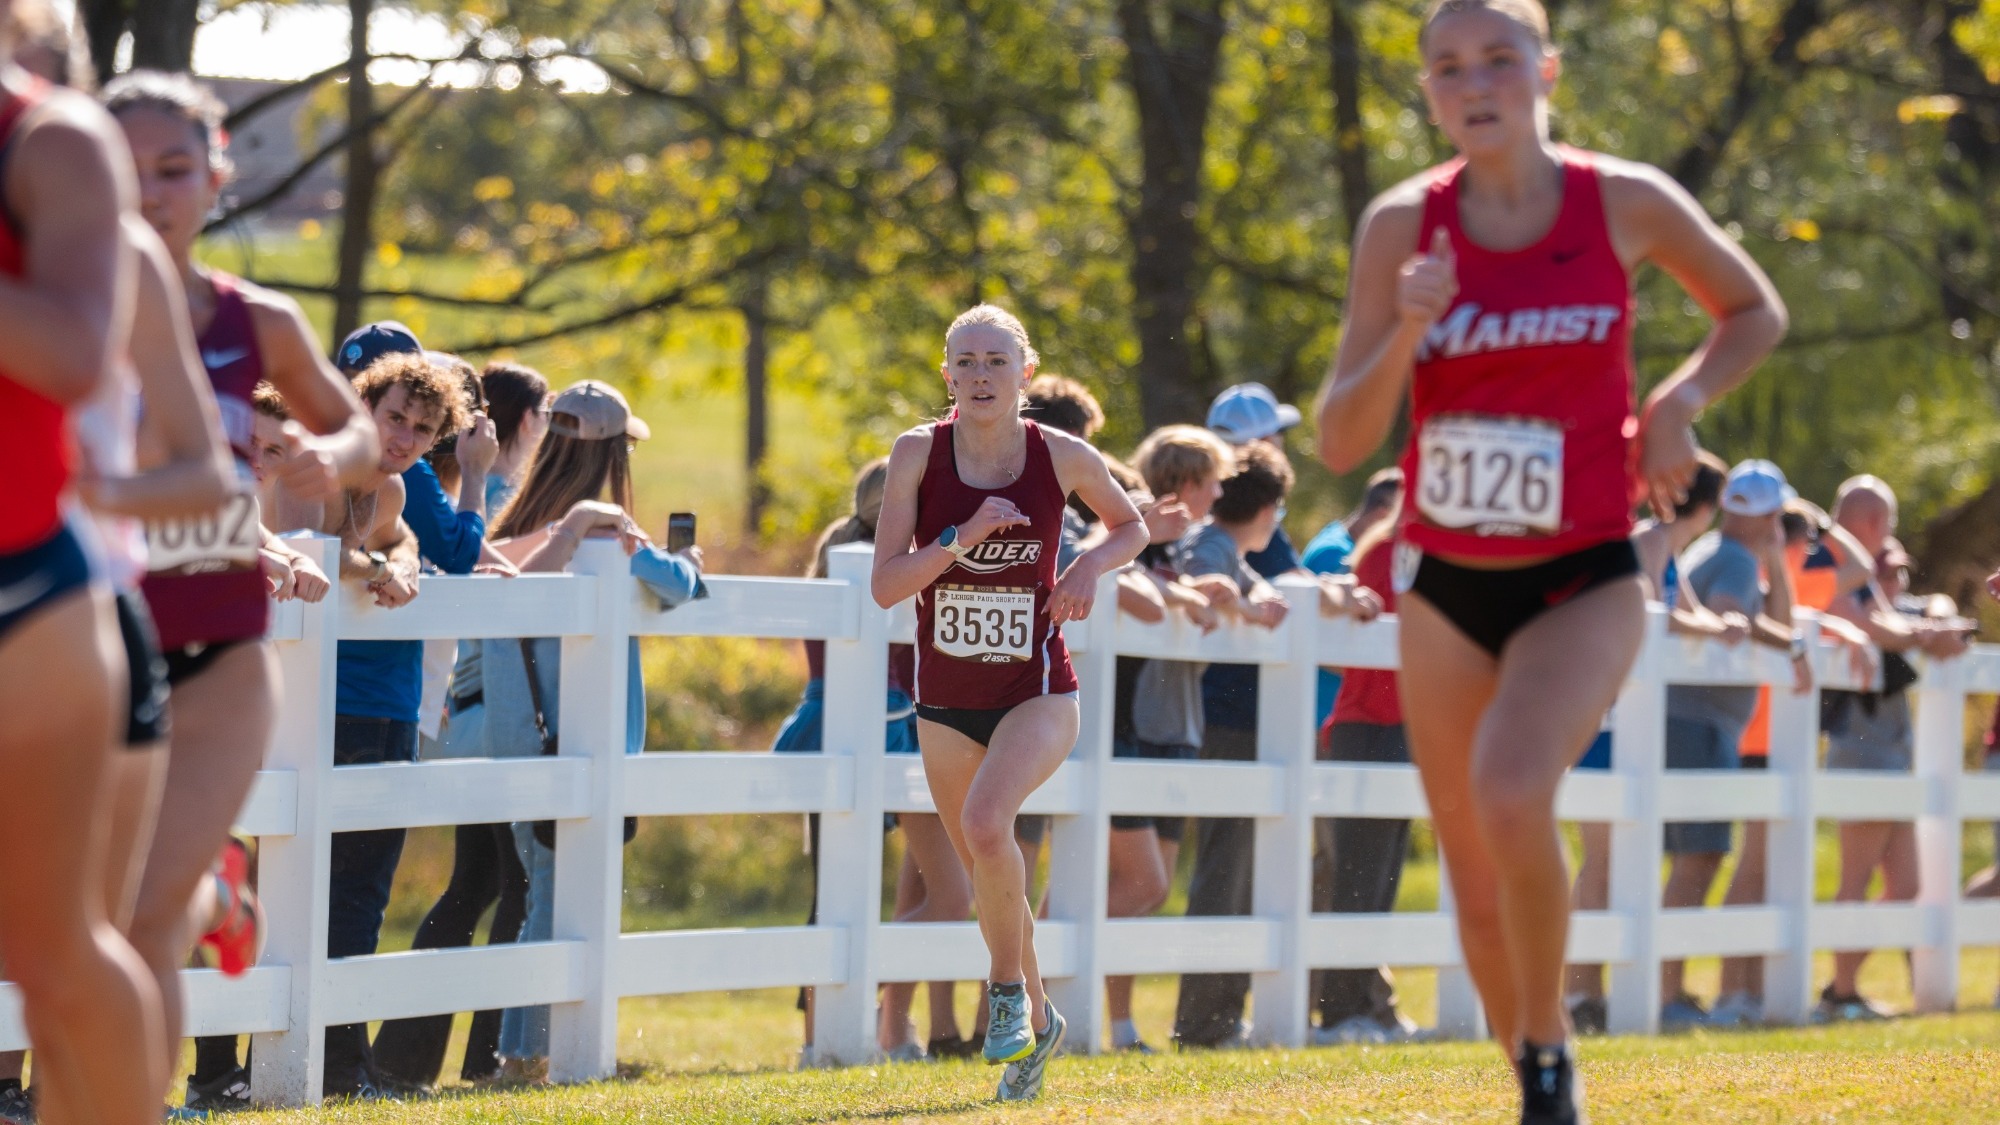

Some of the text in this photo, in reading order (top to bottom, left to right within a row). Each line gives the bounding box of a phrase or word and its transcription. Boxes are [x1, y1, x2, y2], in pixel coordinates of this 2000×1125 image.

[1415, 302, 1621, 363] MARIST
[1426, 446, 1550, 514] 3126
[950, 593, 975, 602] LEHIGH
[977, 595, 994, 603] PAUL
[995, 596, 1016, 604] SHORT
[940, 605, 1028, 649] 3535
[990, 653, 1011, 663] asics
